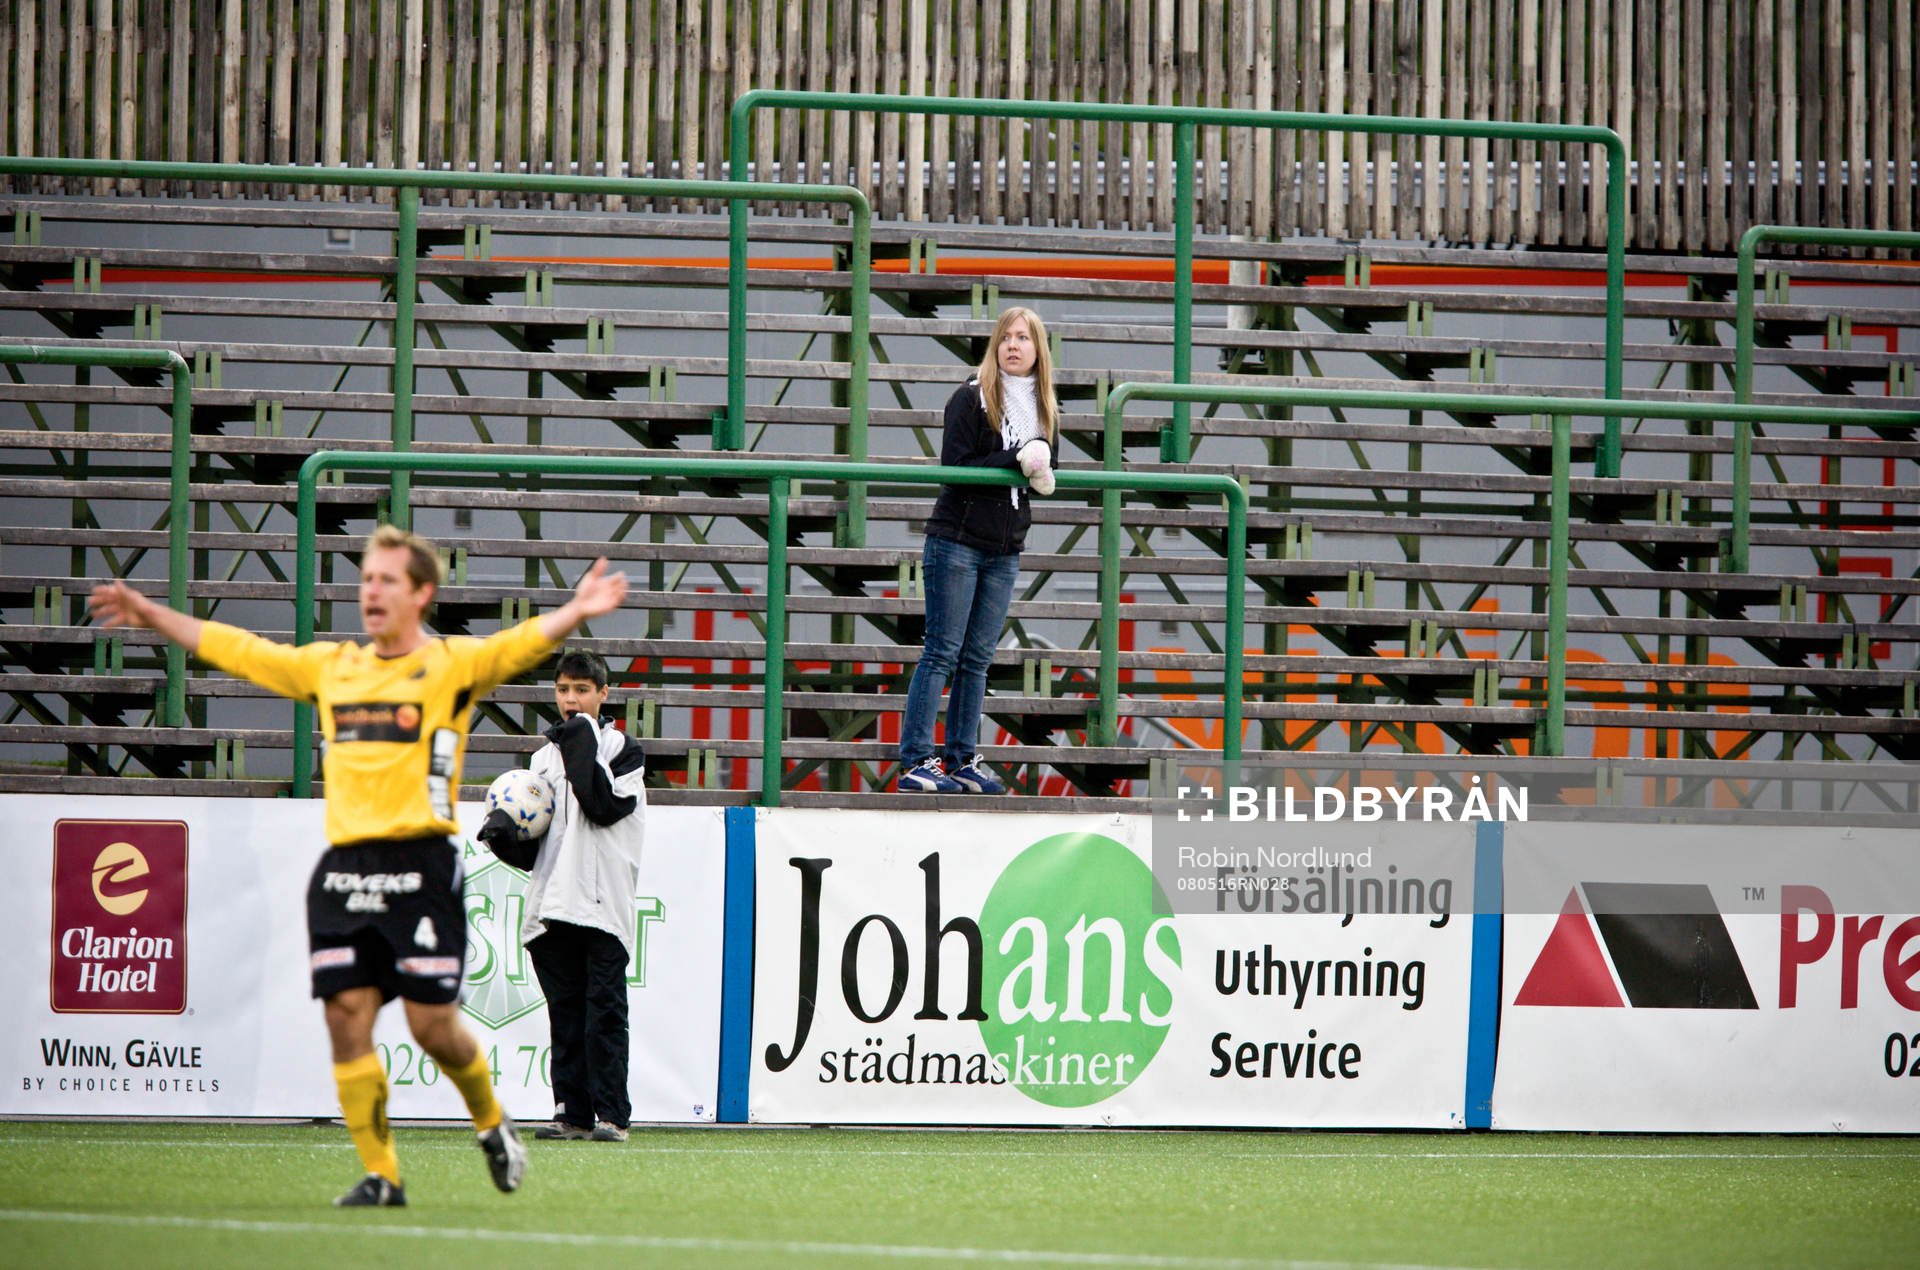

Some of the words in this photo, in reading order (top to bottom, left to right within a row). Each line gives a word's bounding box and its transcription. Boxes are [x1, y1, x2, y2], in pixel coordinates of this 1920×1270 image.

[323, 871, 423, 893] TOVEKS
[1215, 862, 1453, 929] Försäljning
[1742, 887, 1765, 901] TM
[345, 891, 389, 912] BIL
[61, 926, 174, 960] Clarion
[413, 916, 438, 950] 4
[77, 962, 157, 994] Hotel
[765, 851, 1183, 1073] Johans
[1215, 944, 1426, 1011] Uthyrning
[818, 1033, 1134, 1085] städmaskiner
[1209, 1028, 1362, 1079] Service
[22, 1077, 45, 1092] BY
[59, 1077, 131, 1093] CHOICE
[145, 1078, 221, 1093] HOTELS
